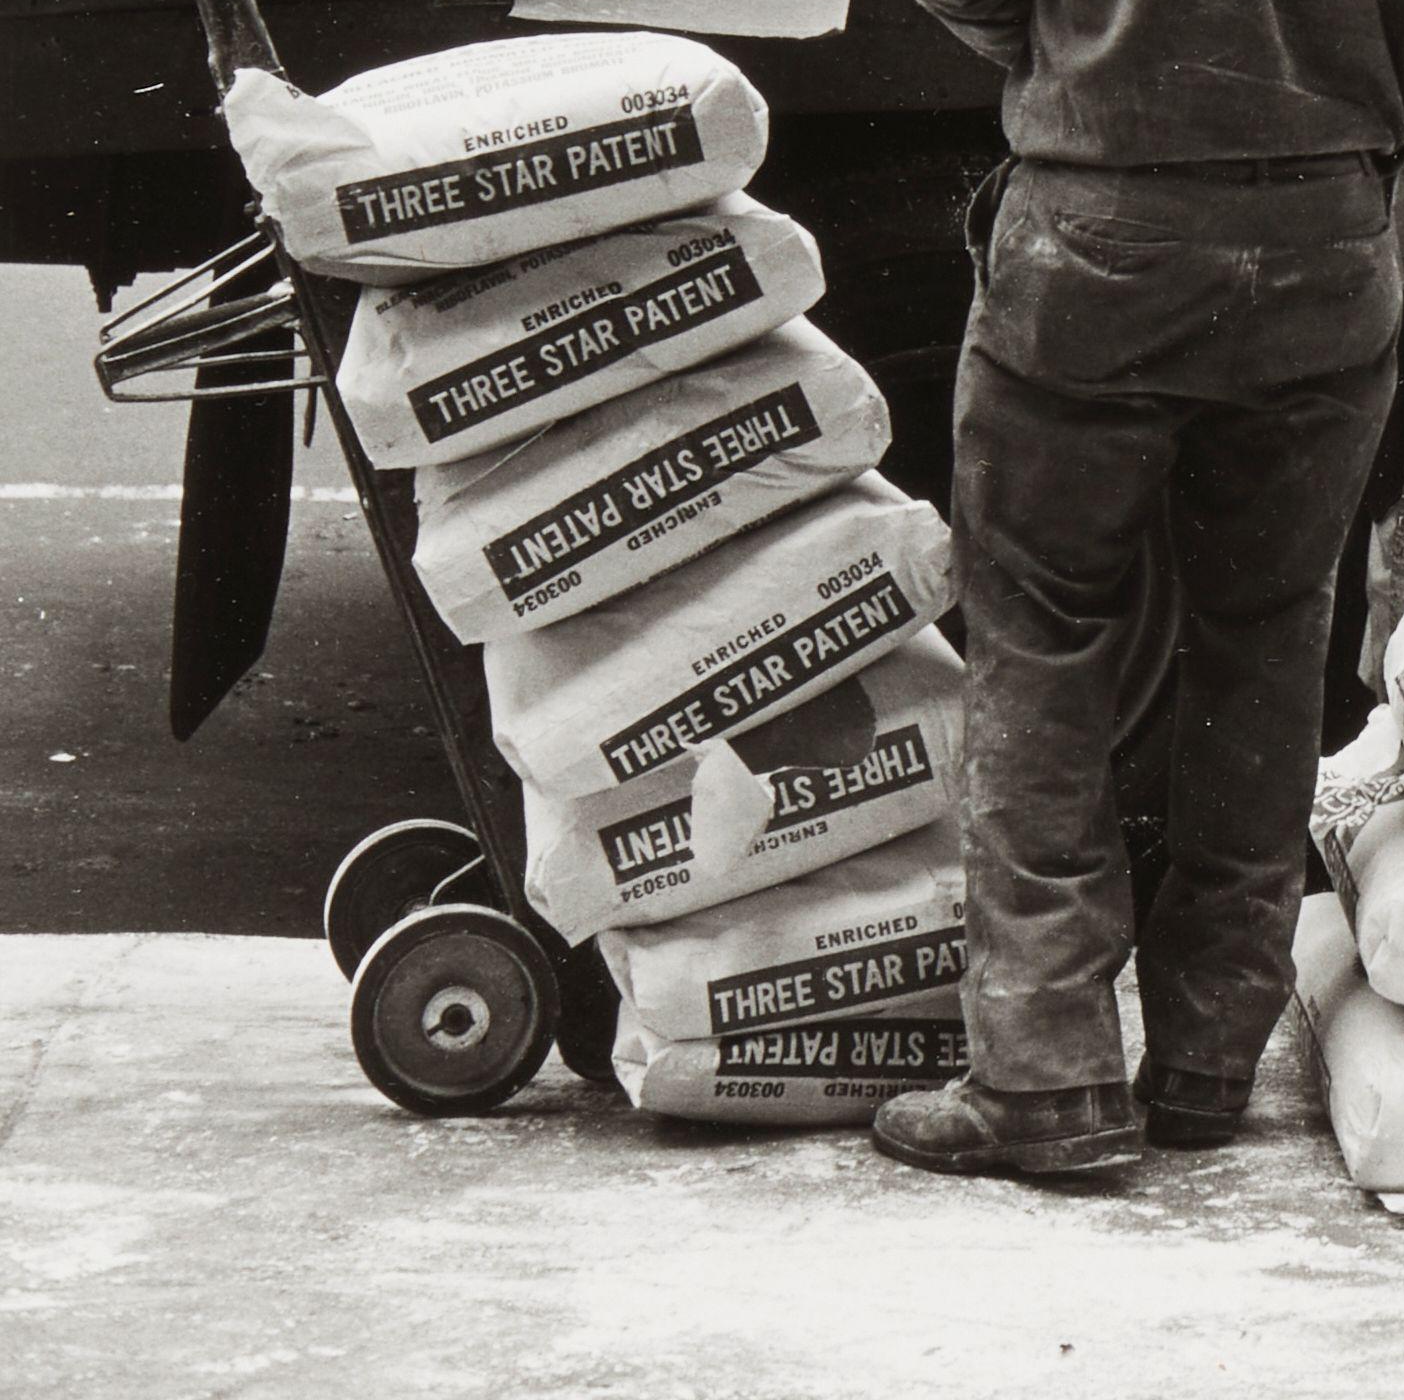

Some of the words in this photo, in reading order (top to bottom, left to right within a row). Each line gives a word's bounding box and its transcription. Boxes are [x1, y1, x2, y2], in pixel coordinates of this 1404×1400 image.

[464, 115, 569, 152] ENRICHED
[620, 84, 690, 115] 003034
[357, 175, 465, 227] THREE
[475, 154, 557, 202] STAR
[566, 122, 678, 180] PATENT
[521, 281, 623, 333] ENRICHED
[666, 228, 736, 268] 003034
[429, 356, 535, 424] THREE
[539, 318, 620, 377] STAR
[624, 264, 736, 336] PATENT
[701, 404, 800, 469] THREE
[622, 449, 703, 509] STAR
[510, 493, 623, 579] PATENT
[626, 490, 723, 551] ENRICHED
[512, 569, 582, 617] 003034
[691, 612, 788, 676] ENRICHED
[816, 552, 884, 601] 003034
[610, 701, 713, 776] THREE
[713, 654, 793, 717] STAR
[792, 585, 902, 670] PATENT
[778, 775, 817, 817] ST
[822, 740, 926, 800] THREE
[615, 807, 692, 872] TENT
[748, 819, 829, 858] ENRICH
[621, 867, 691, 904] 003034
[815, 915, 919, 950] ENRICHED
[714, 972, 816, 1024] THREE
[825, 954, 905, 1001] STAR
[915, 939, 968, 981] PAT
[725, 1030, 840, 1067] PATENT
[850, 1031, 926, 1067] STAR
[714, 1080, 785, 1099] 003034
